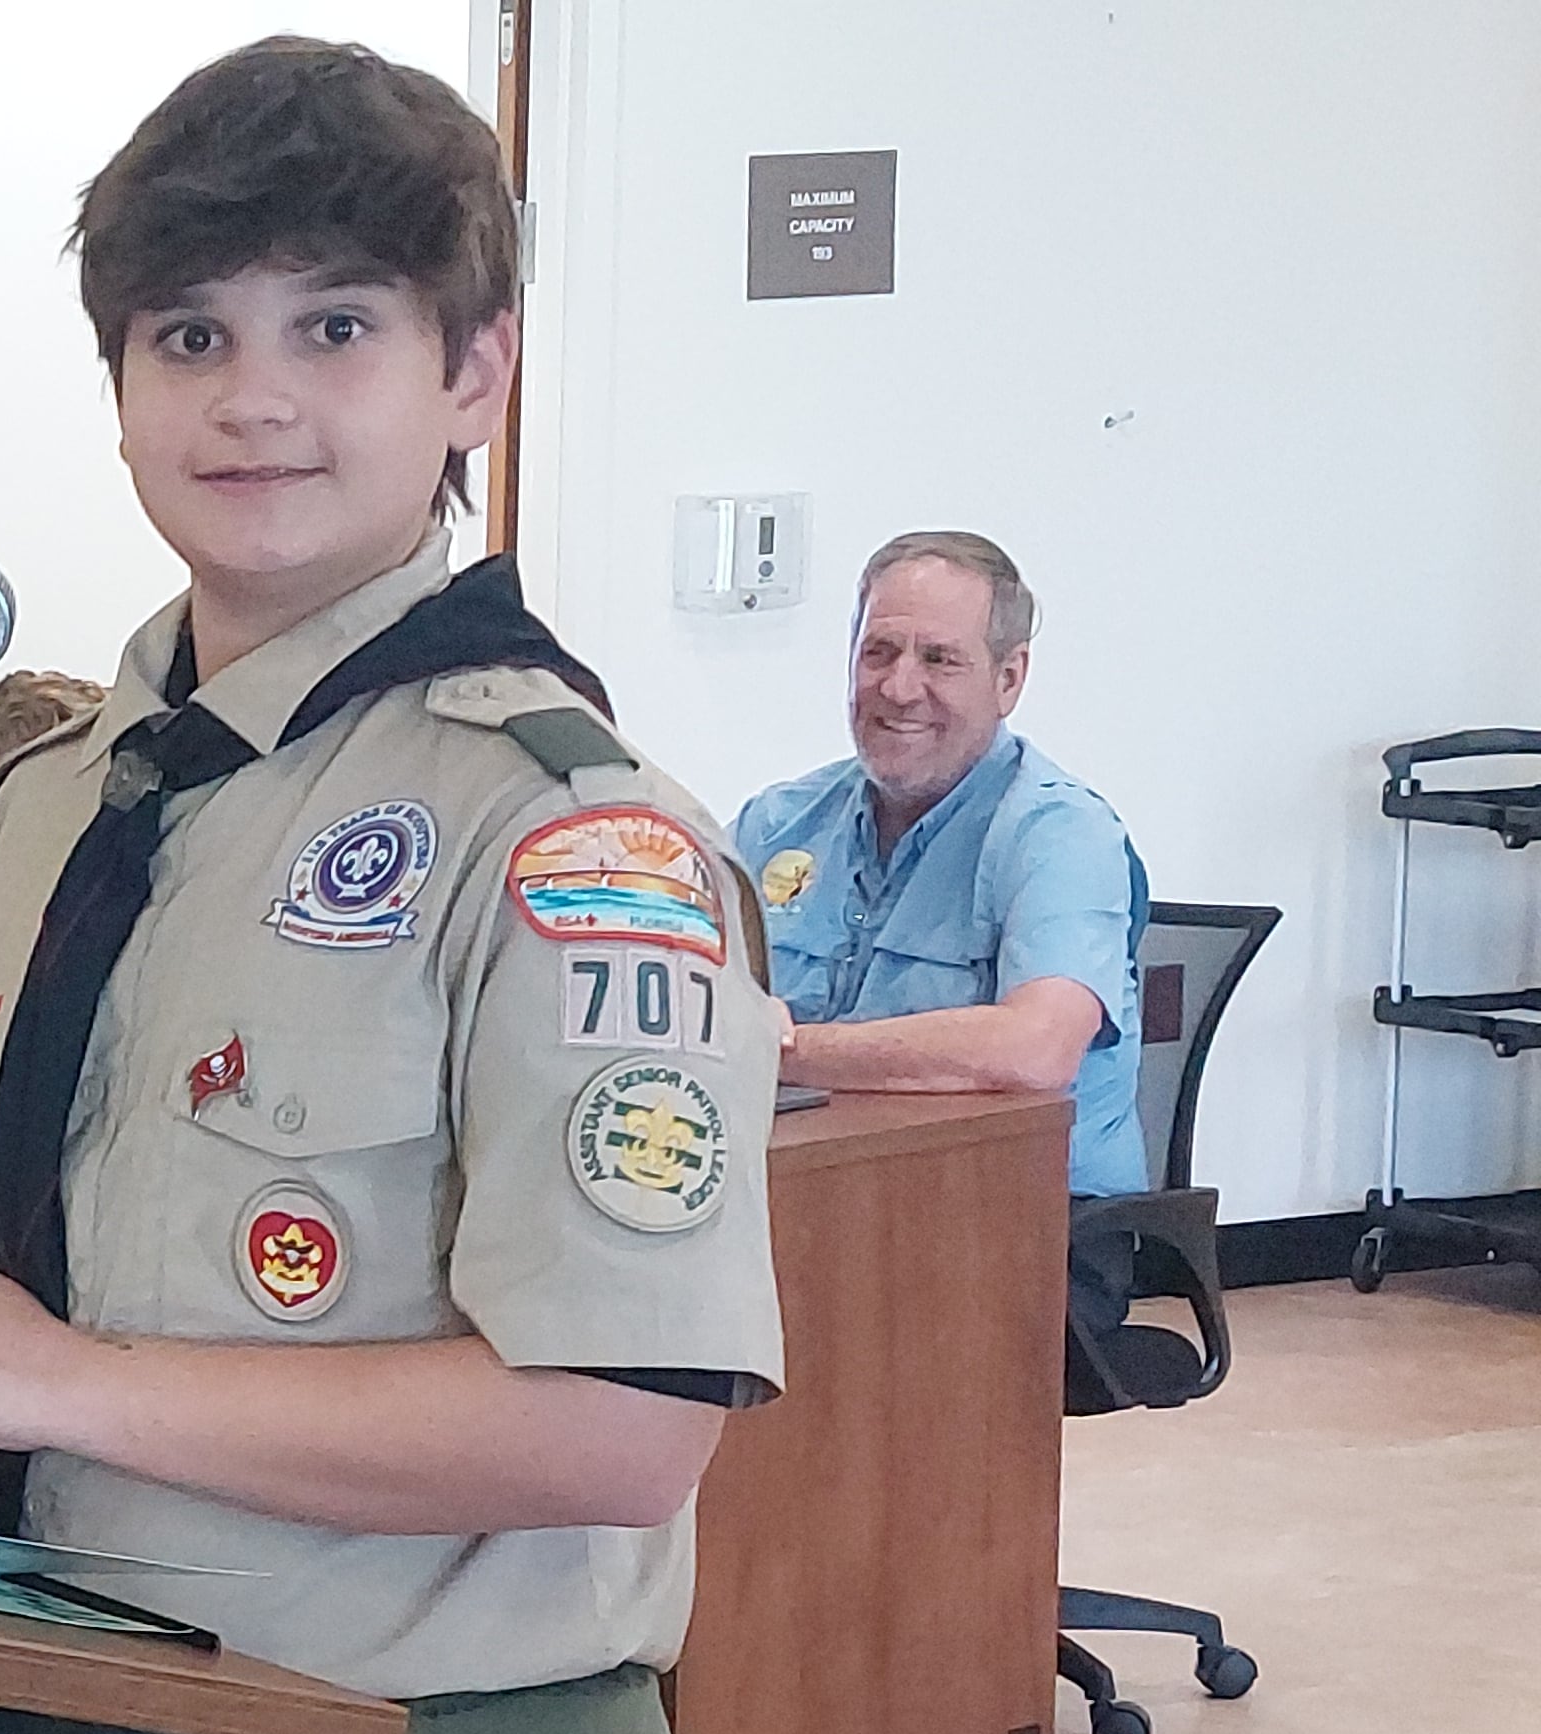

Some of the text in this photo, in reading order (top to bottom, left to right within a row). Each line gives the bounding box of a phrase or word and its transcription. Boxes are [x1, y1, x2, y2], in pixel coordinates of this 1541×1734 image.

[790, 190, 855, 207] MAXIMUM
[789, 216, 855, 235] CAPACITY
[572, 960, 713, 1043] 707
